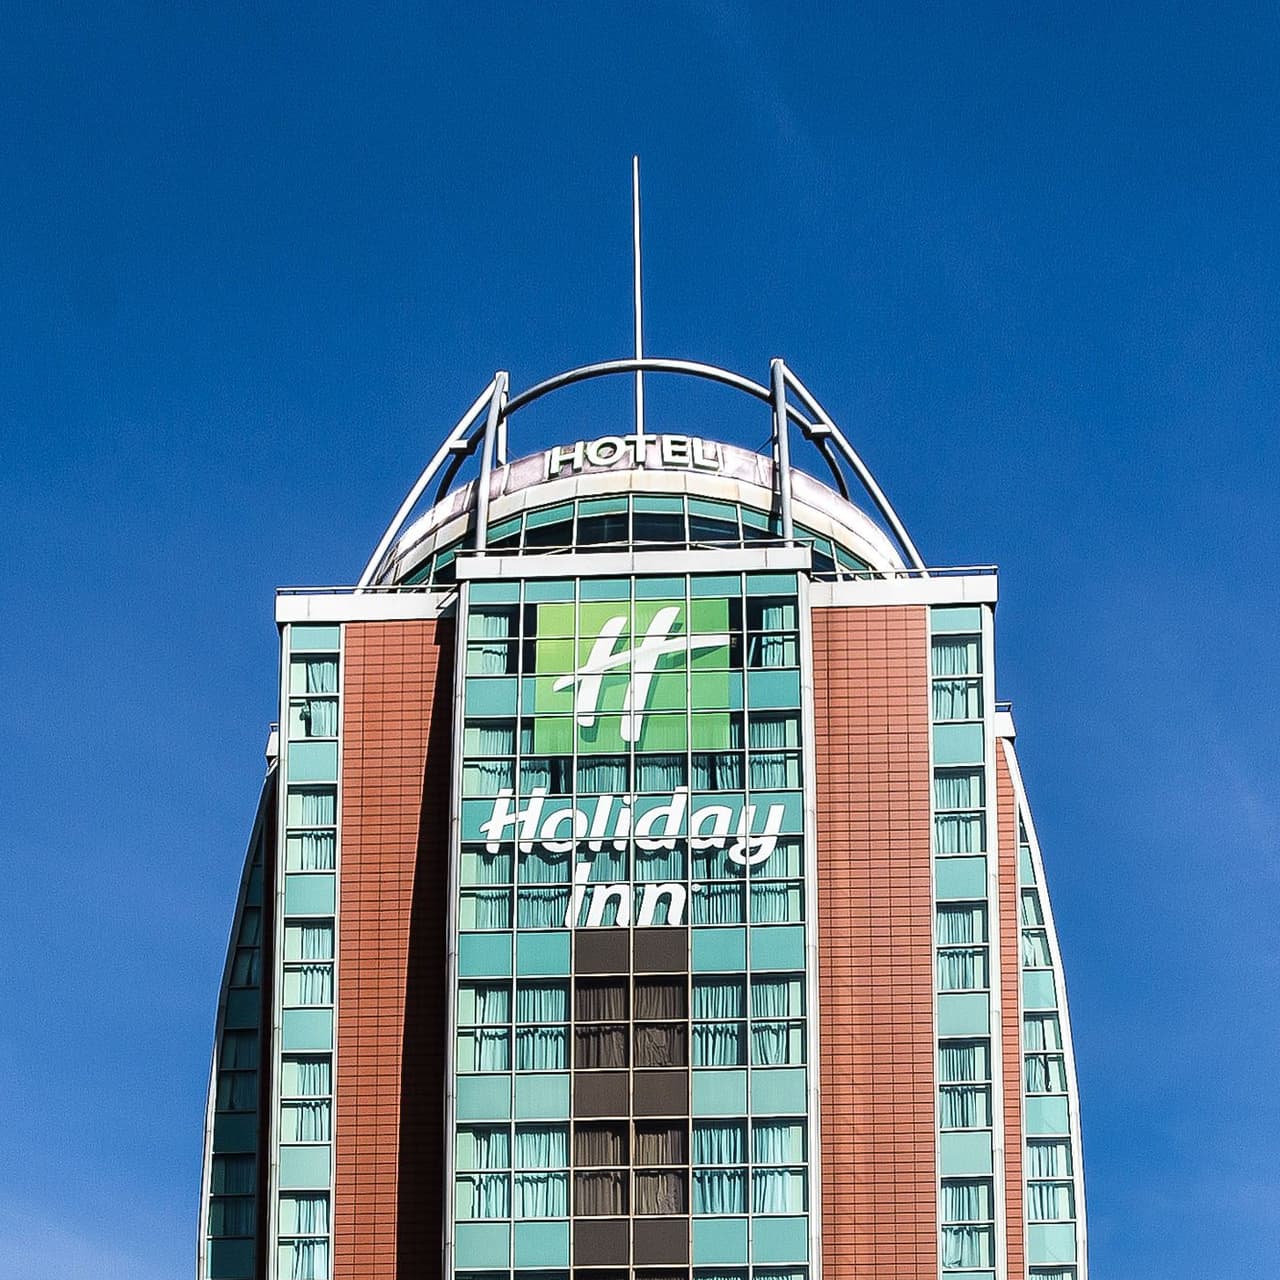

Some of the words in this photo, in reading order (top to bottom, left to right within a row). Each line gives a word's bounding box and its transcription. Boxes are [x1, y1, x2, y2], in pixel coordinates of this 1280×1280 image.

[548, 433, 720, 479] HOTEL
[479, 785, 785, 866] Holiday
[564, 862, 689, 928] Inn
